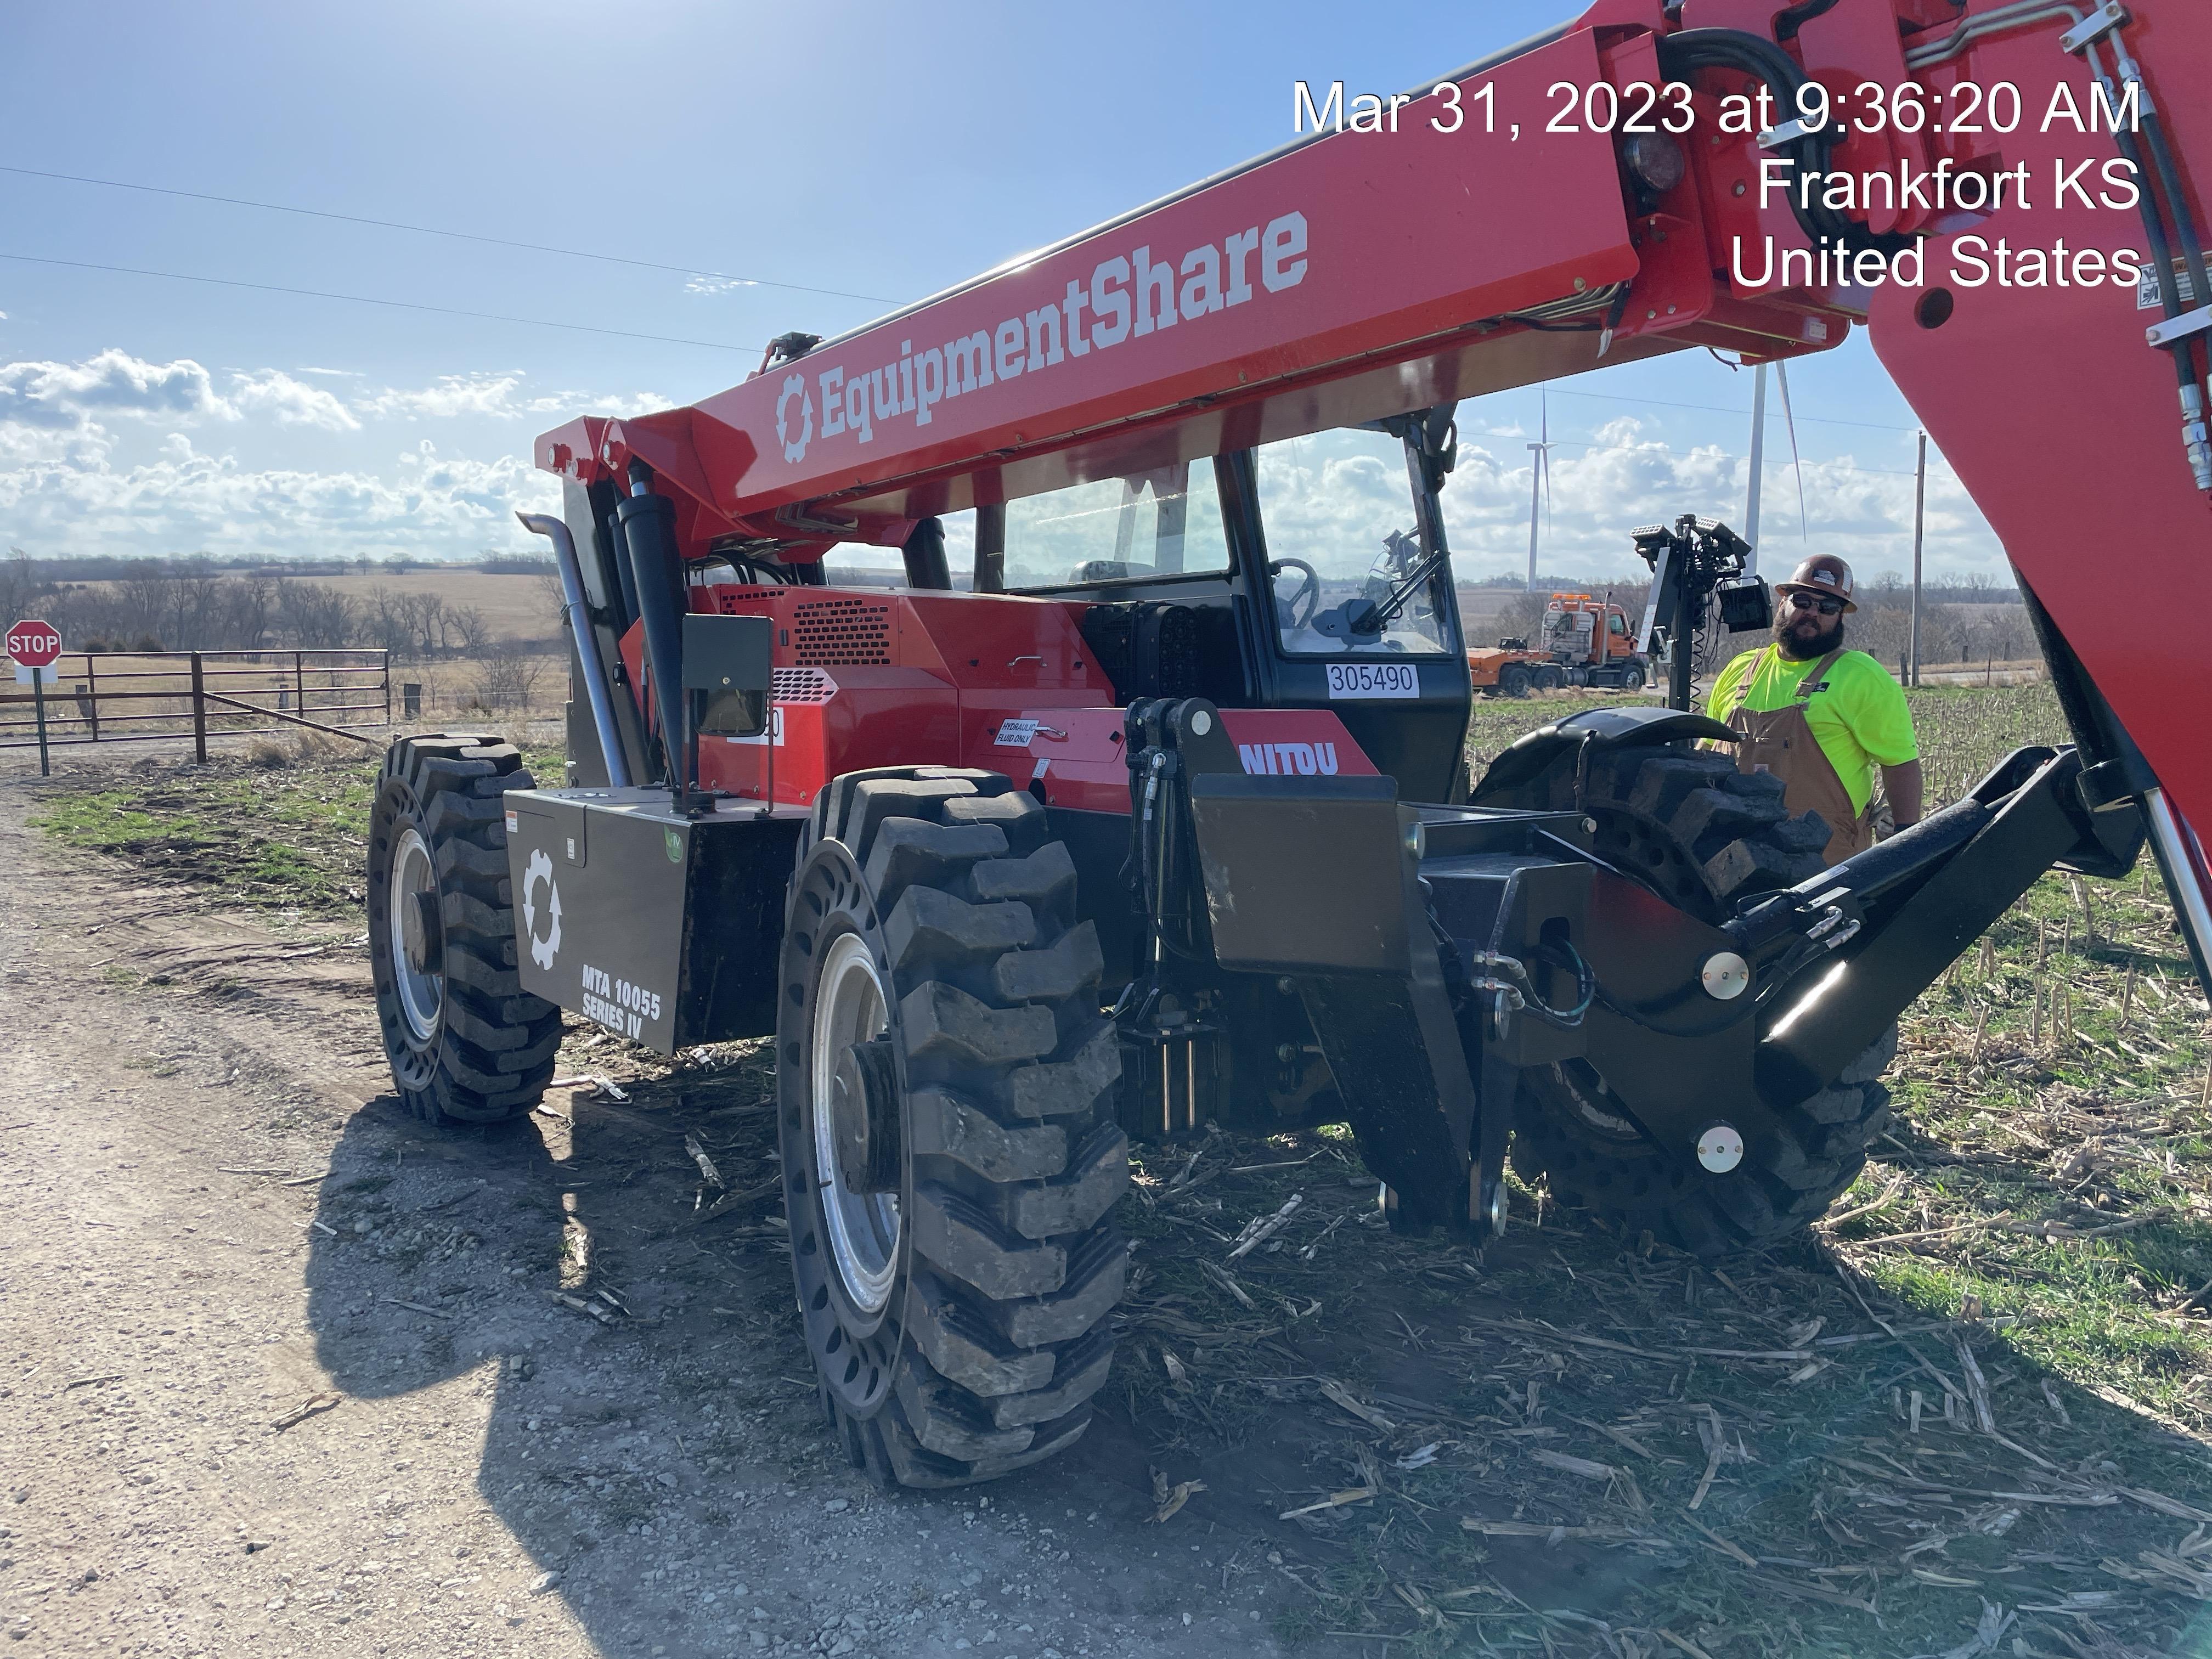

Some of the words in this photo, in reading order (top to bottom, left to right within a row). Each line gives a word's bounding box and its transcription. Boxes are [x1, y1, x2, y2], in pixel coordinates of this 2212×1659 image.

[819, 210, 1309, 444] EquipmentShare
[9, 635, 58, 653] STOP
[1330, 665, 1413, 691] 305490
[1002, 723, 1036, 731] HYDRAULIC
[582, 964, 611, 998] MTA
[615, 979, 661, 1020] 10055
[582, 992, 624, 1031] SERIES
[627, 1013, 642, 1040] IV
